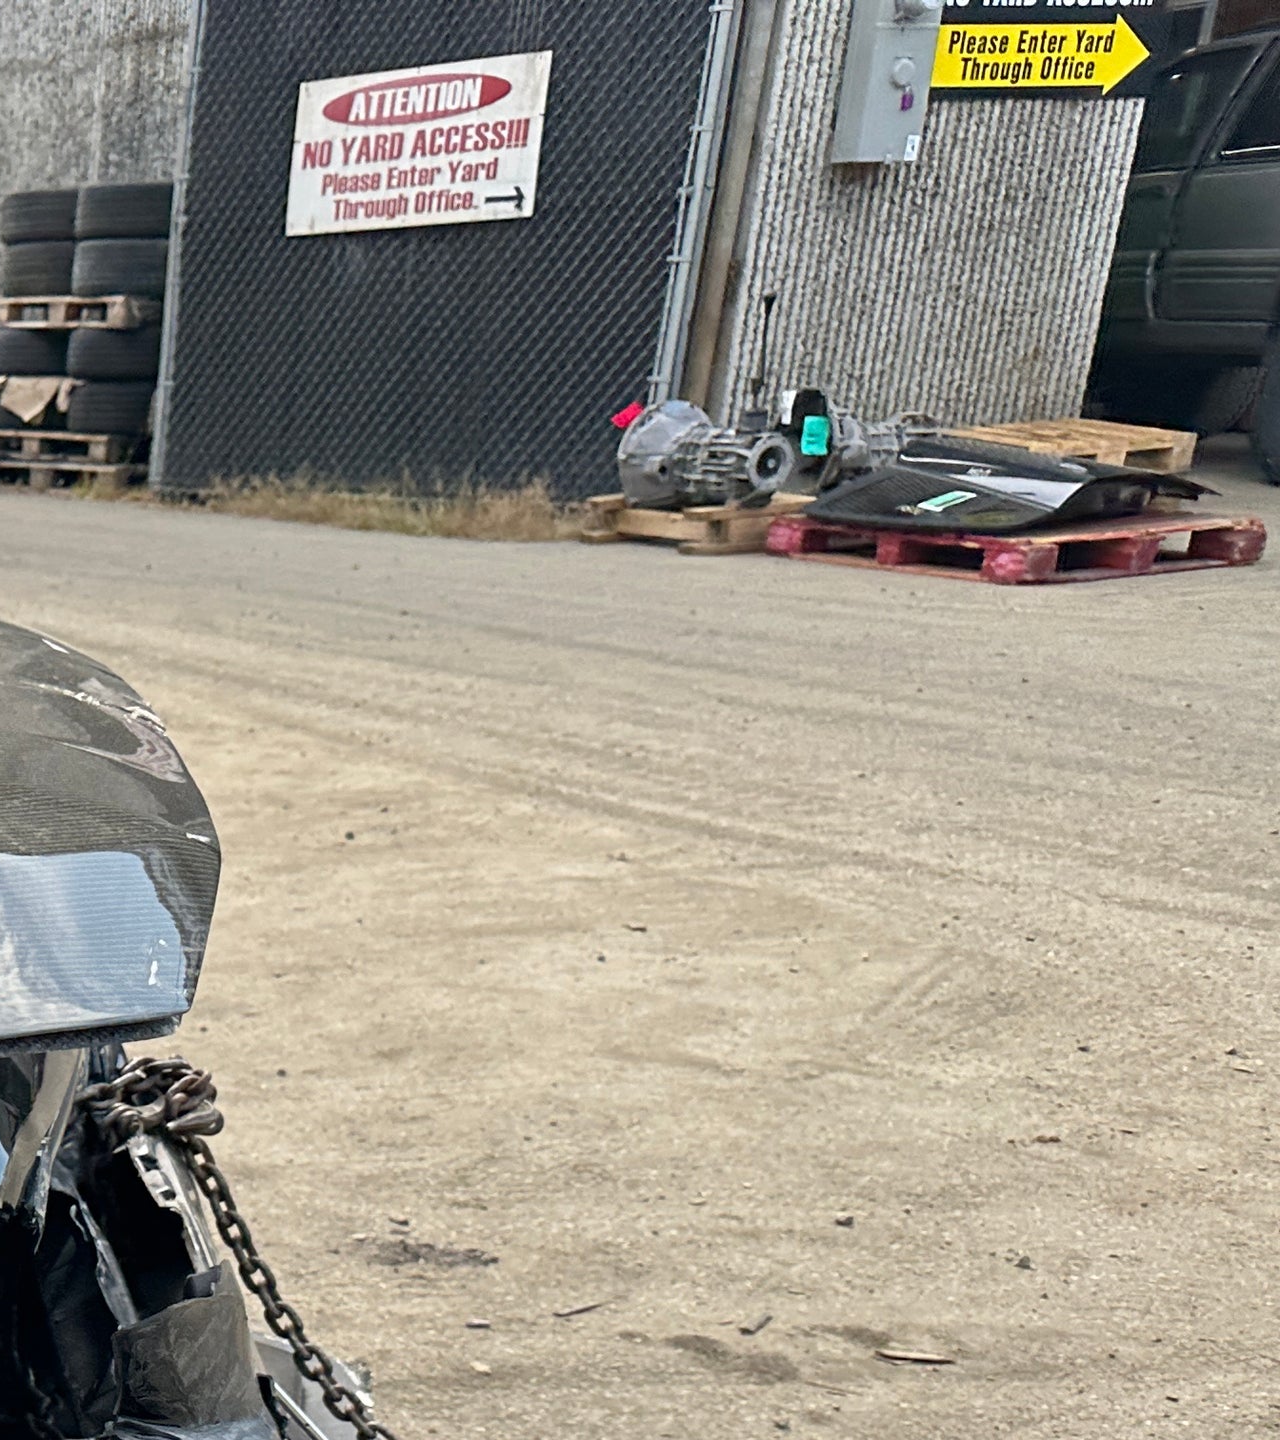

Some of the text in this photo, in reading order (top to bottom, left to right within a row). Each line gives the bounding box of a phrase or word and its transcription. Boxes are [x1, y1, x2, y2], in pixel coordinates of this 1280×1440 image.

[948, 29, 1116, 54] Please Enter Yard
[960, 56, 1096, 84] Through Office
[348, 76, 483, 122] ATTENTION
[301, 118, 531, 171] NO YARD ACCESS!!!
[321, 157, 500, 197] Please Enter Yard
[333, 195, 408, 222] Through
